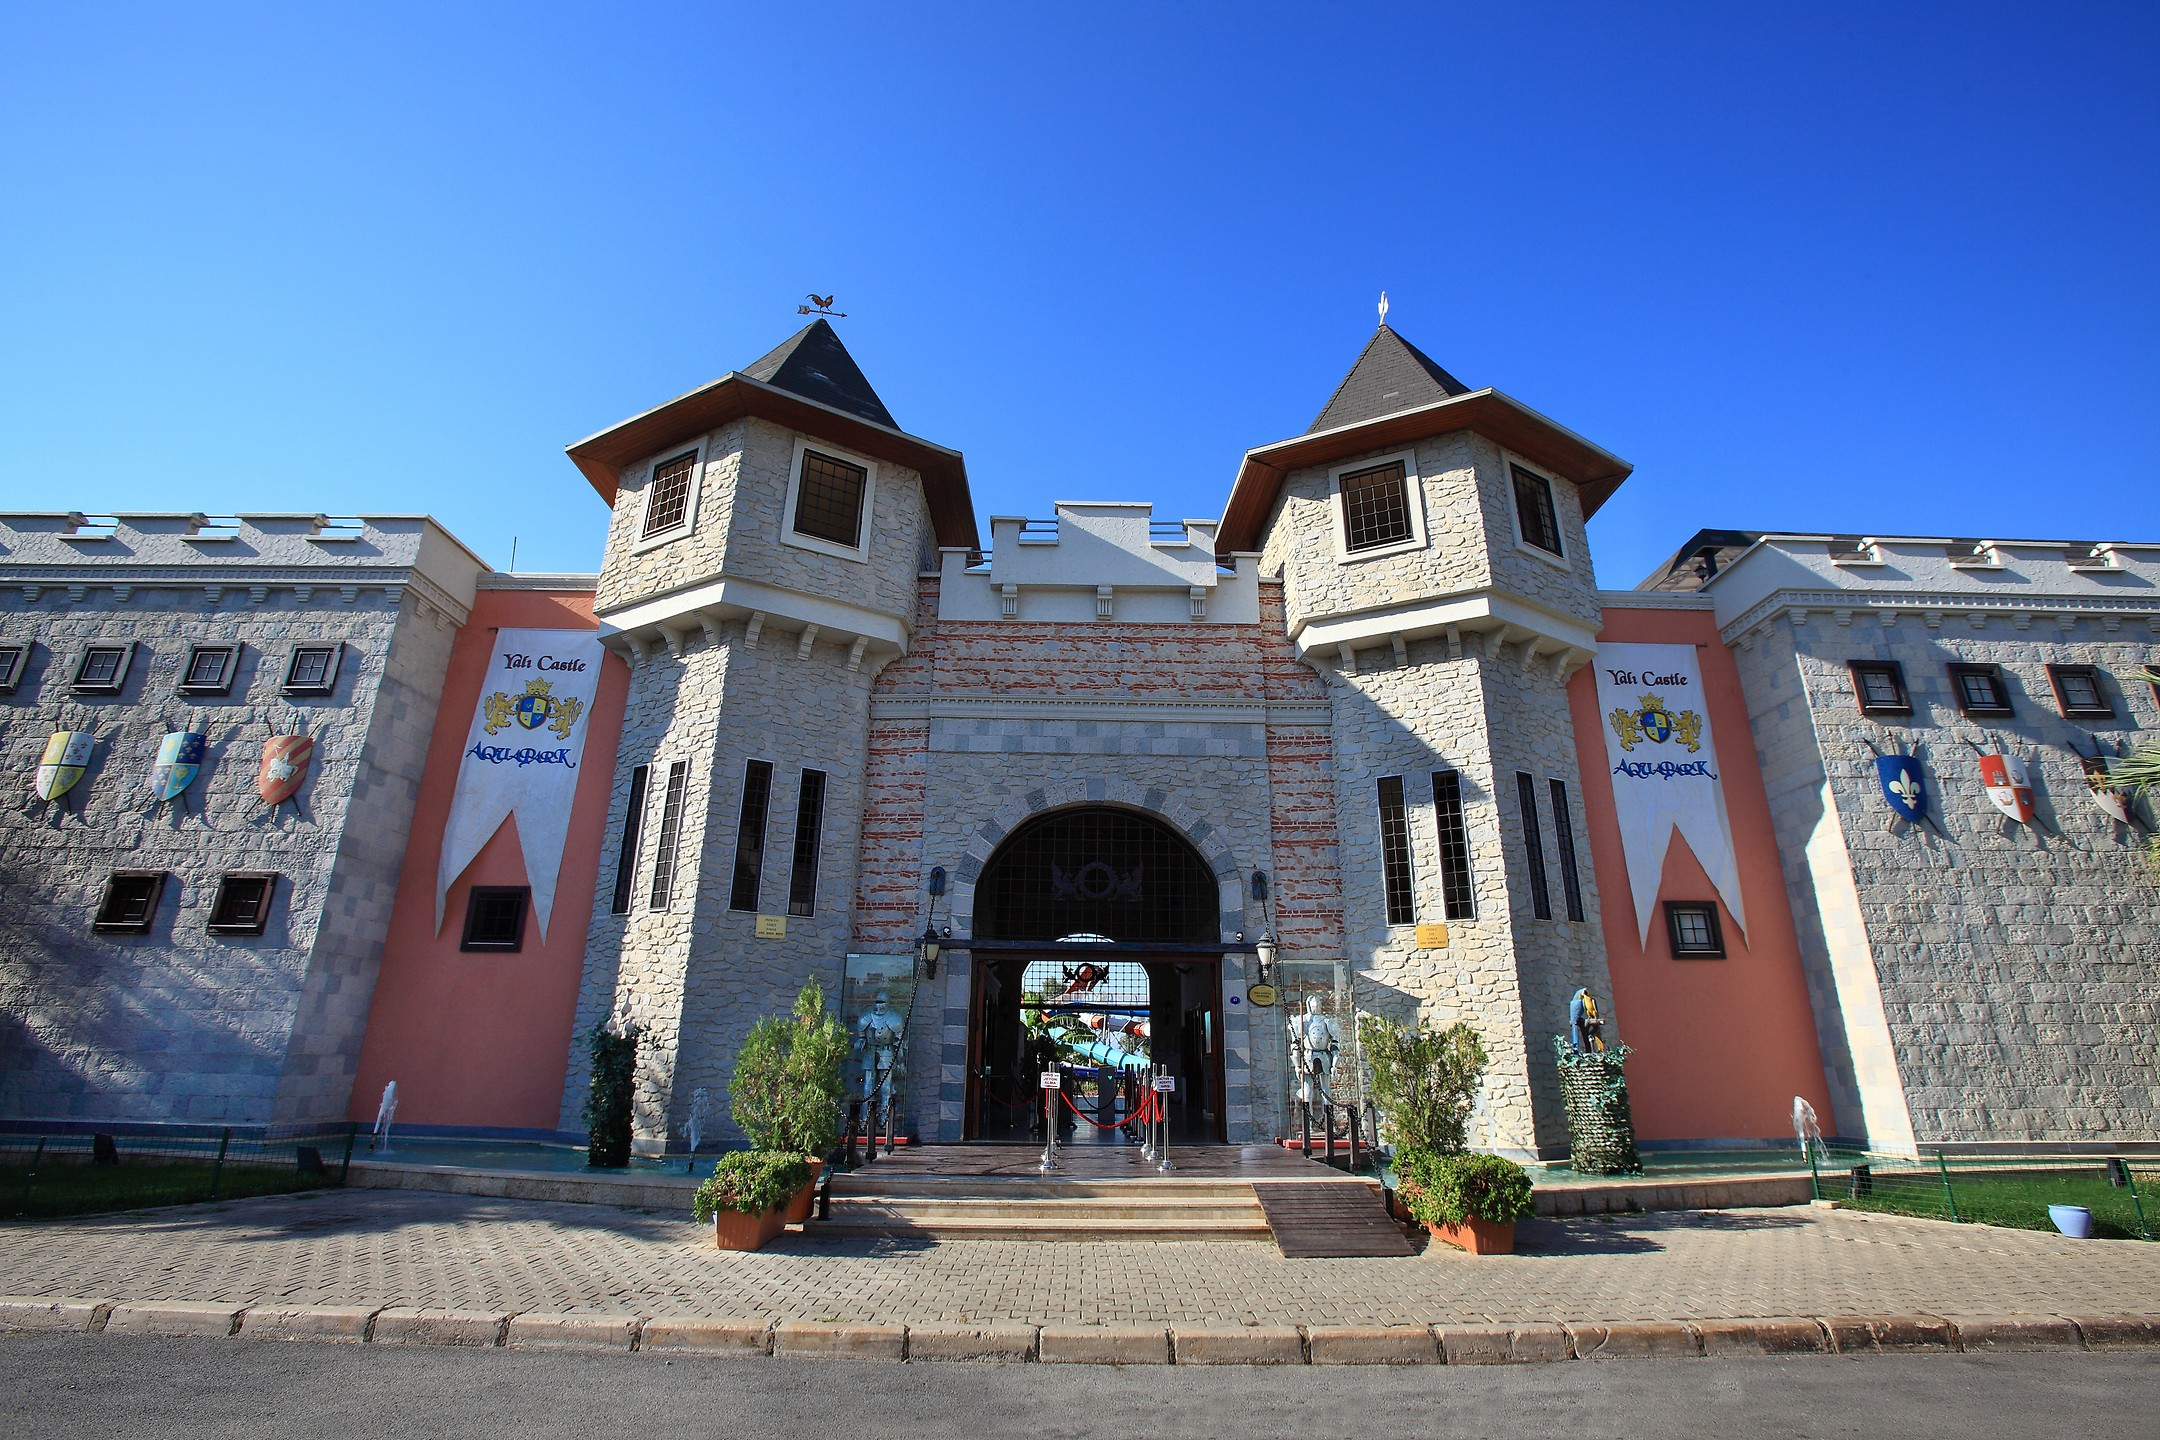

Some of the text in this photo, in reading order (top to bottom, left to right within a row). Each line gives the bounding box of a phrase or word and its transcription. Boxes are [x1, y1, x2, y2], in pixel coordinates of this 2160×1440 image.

[503, 653, 587, 672] Yalı Castle
[1606, 669, 1688, 686] Yalı Castle
[465, 741, 576, 768] AQUAPARK
[1612, 758, 1717, 780] AQUAPARK
